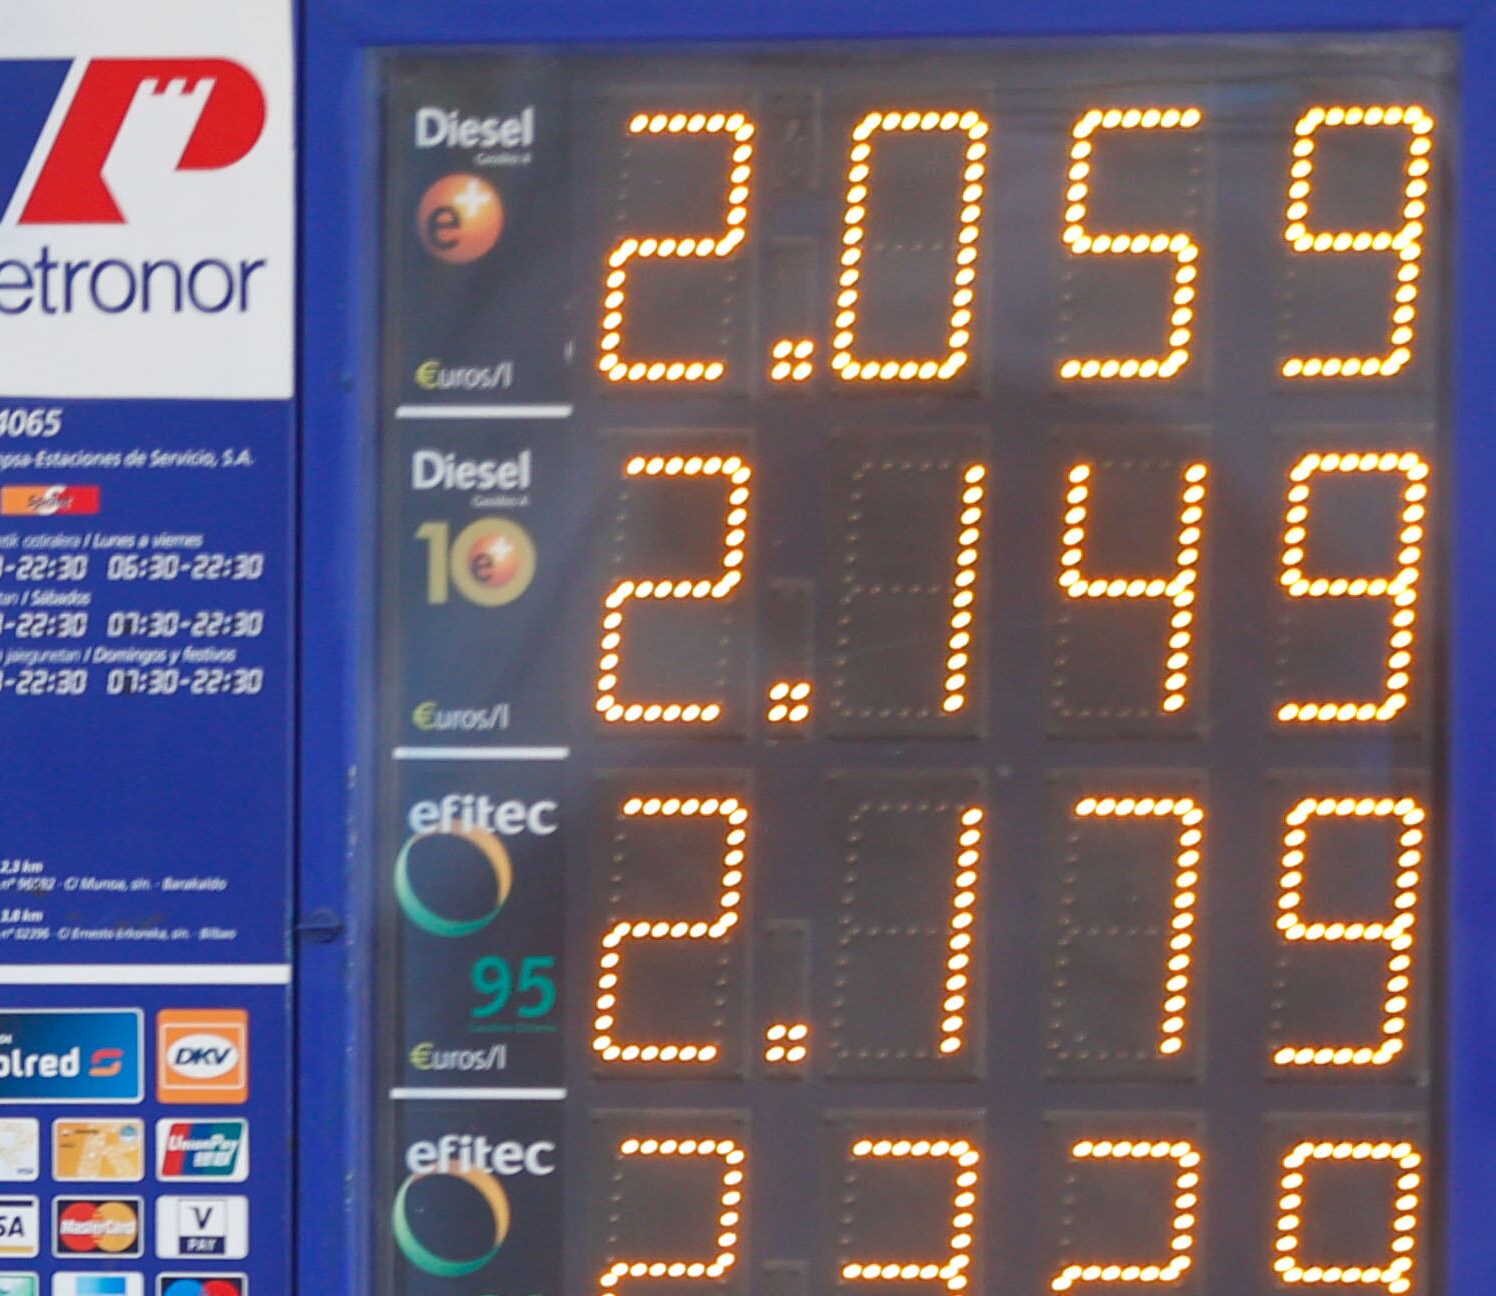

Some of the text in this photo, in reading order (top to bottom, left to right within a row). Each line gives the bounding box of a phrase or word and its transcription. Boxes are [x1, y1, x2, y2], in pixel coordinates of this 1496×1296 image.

[415, 105, 536, 149] Diesel
[595, 103, 1436, 383] 2.059
[122, 449, 147, 467] de
[412, 448, 531, 491] Diesel
[106, 552, 264, 580] 06:30-22:30
[592, 448, 1433, 723] 2.149
[106, 610, 264, 637] 07:30-22:30
[106, 667, 263, 694] 07:30-22:30
[408, 794, 559, 835] efitec
[589, 793, 1429, 1068] 2.179
[471, 954, 557, 1019] 95
[174, 1046, 232, 1066] DKV
[405, 1134, 556, 1176] efitec
[60, 1219, 137, 1236] MasterCard
[191, 1207, 213, 1230] V
[185, 1237, 217, 1251] PAY
